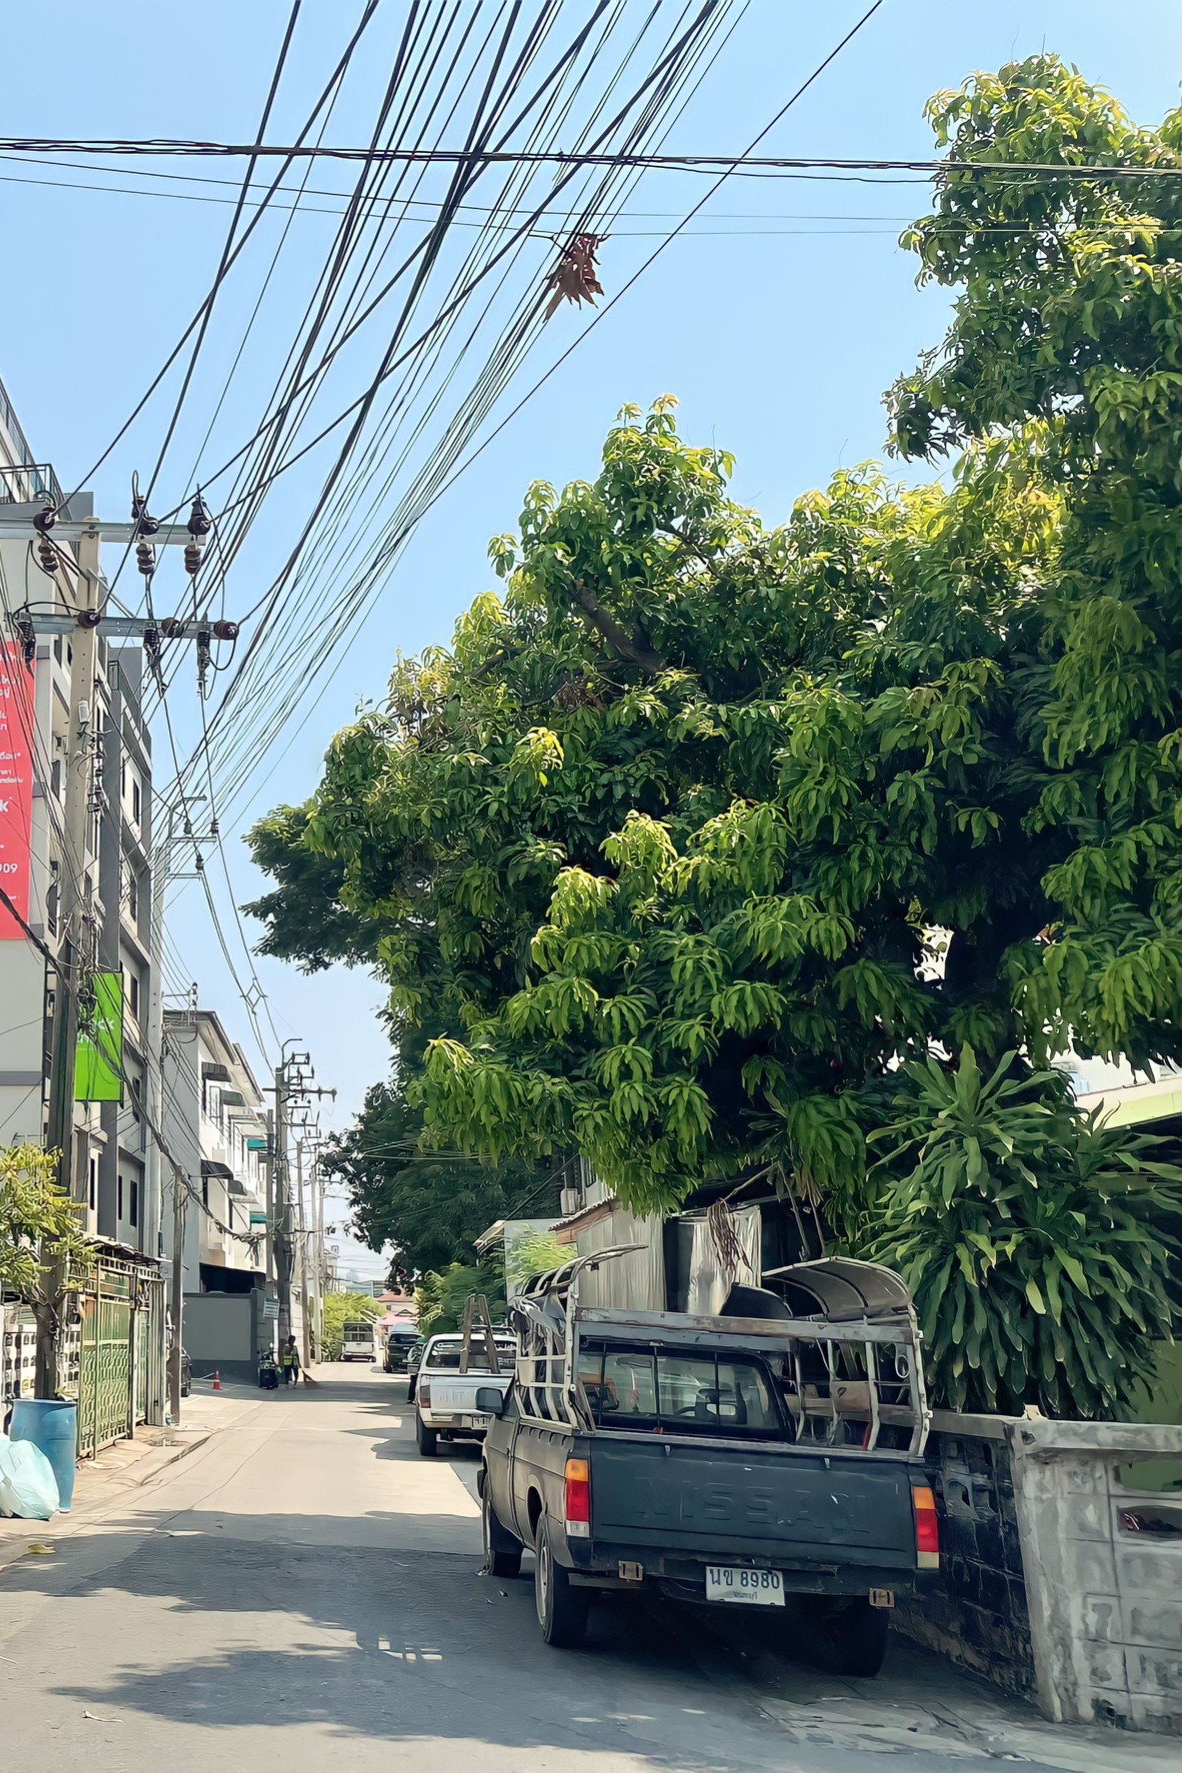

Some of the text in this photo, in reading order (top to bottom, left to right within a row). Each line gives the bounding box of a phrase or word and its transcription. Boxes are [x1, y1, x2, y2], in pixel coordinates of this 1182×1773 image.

[636, 1475, 870, 1534] NISSAN
[709, 1568, 780, 1589] นข 8980
